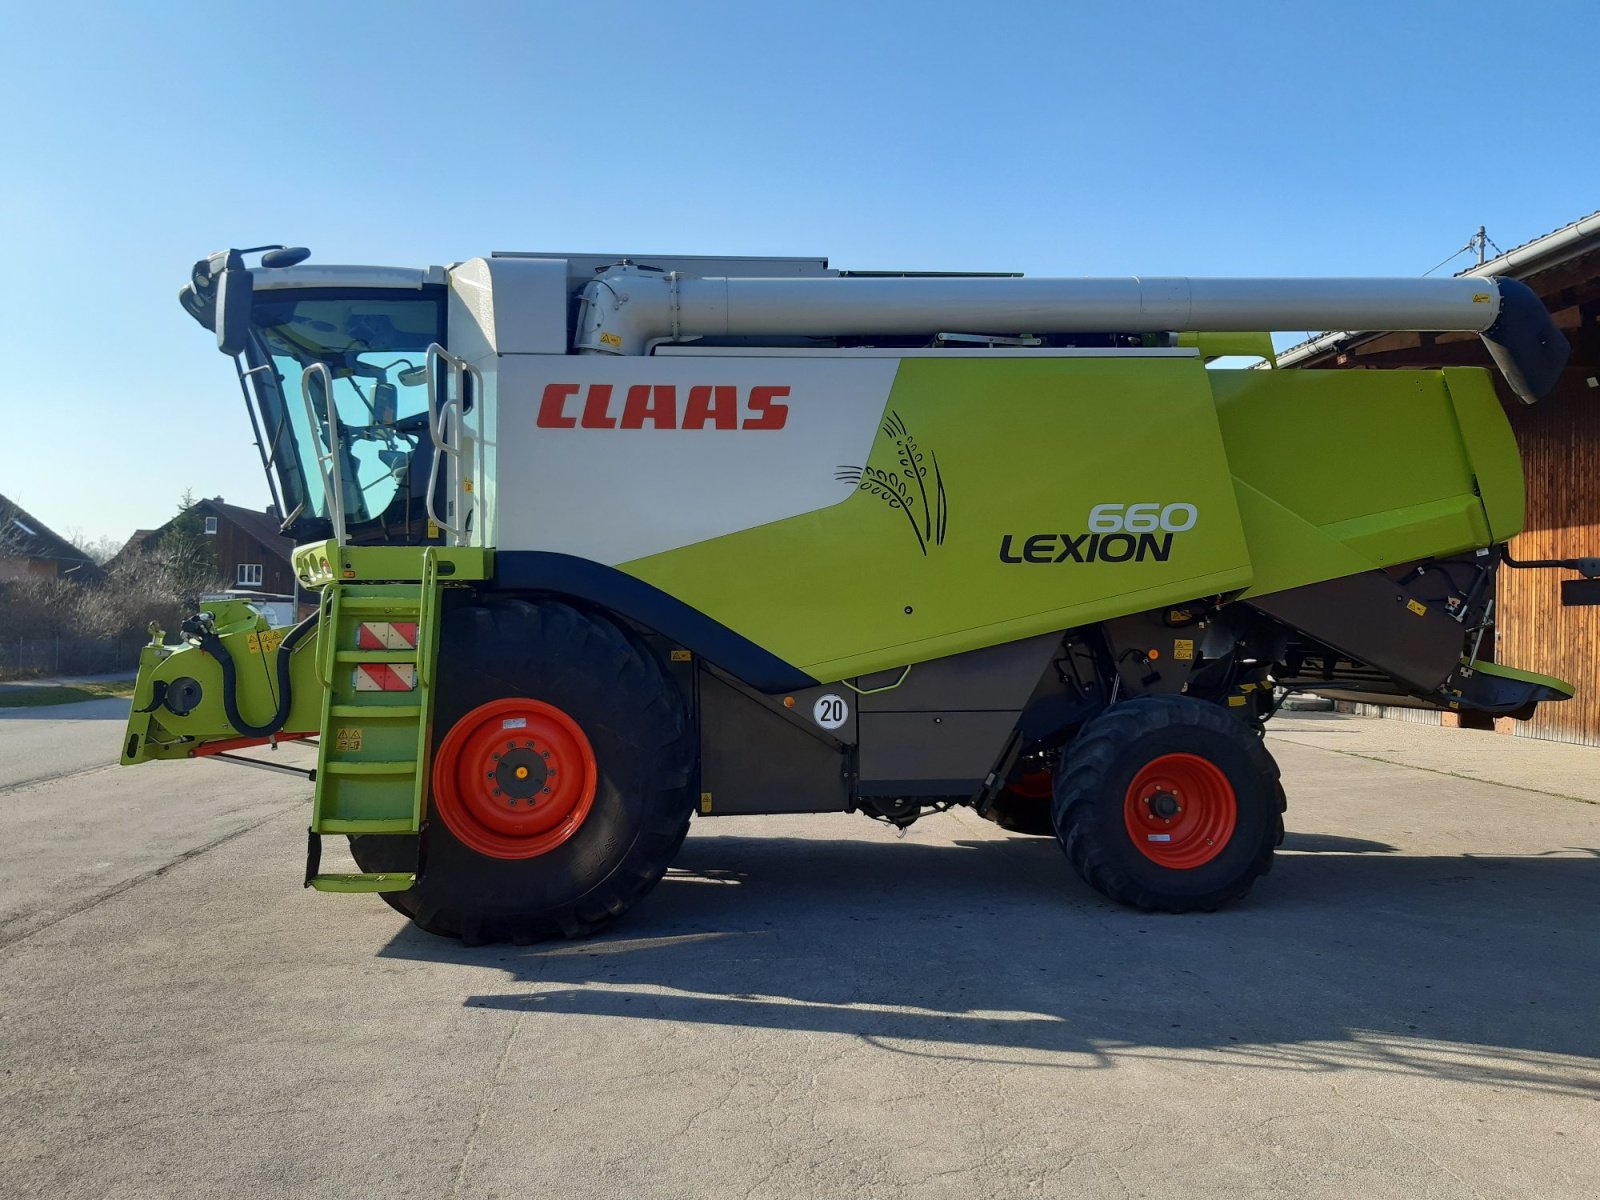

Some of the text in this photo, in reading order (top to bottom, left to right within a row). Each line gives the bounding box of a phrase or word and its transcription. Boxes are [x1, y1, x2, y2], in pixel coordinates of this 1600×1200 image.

[536, 383, 791, 430] CLAAS
[1087, 502, 1198, 533] 660
[1000, 532, 1174, 564] LEXION
[820, 699, 843, 722] 20
